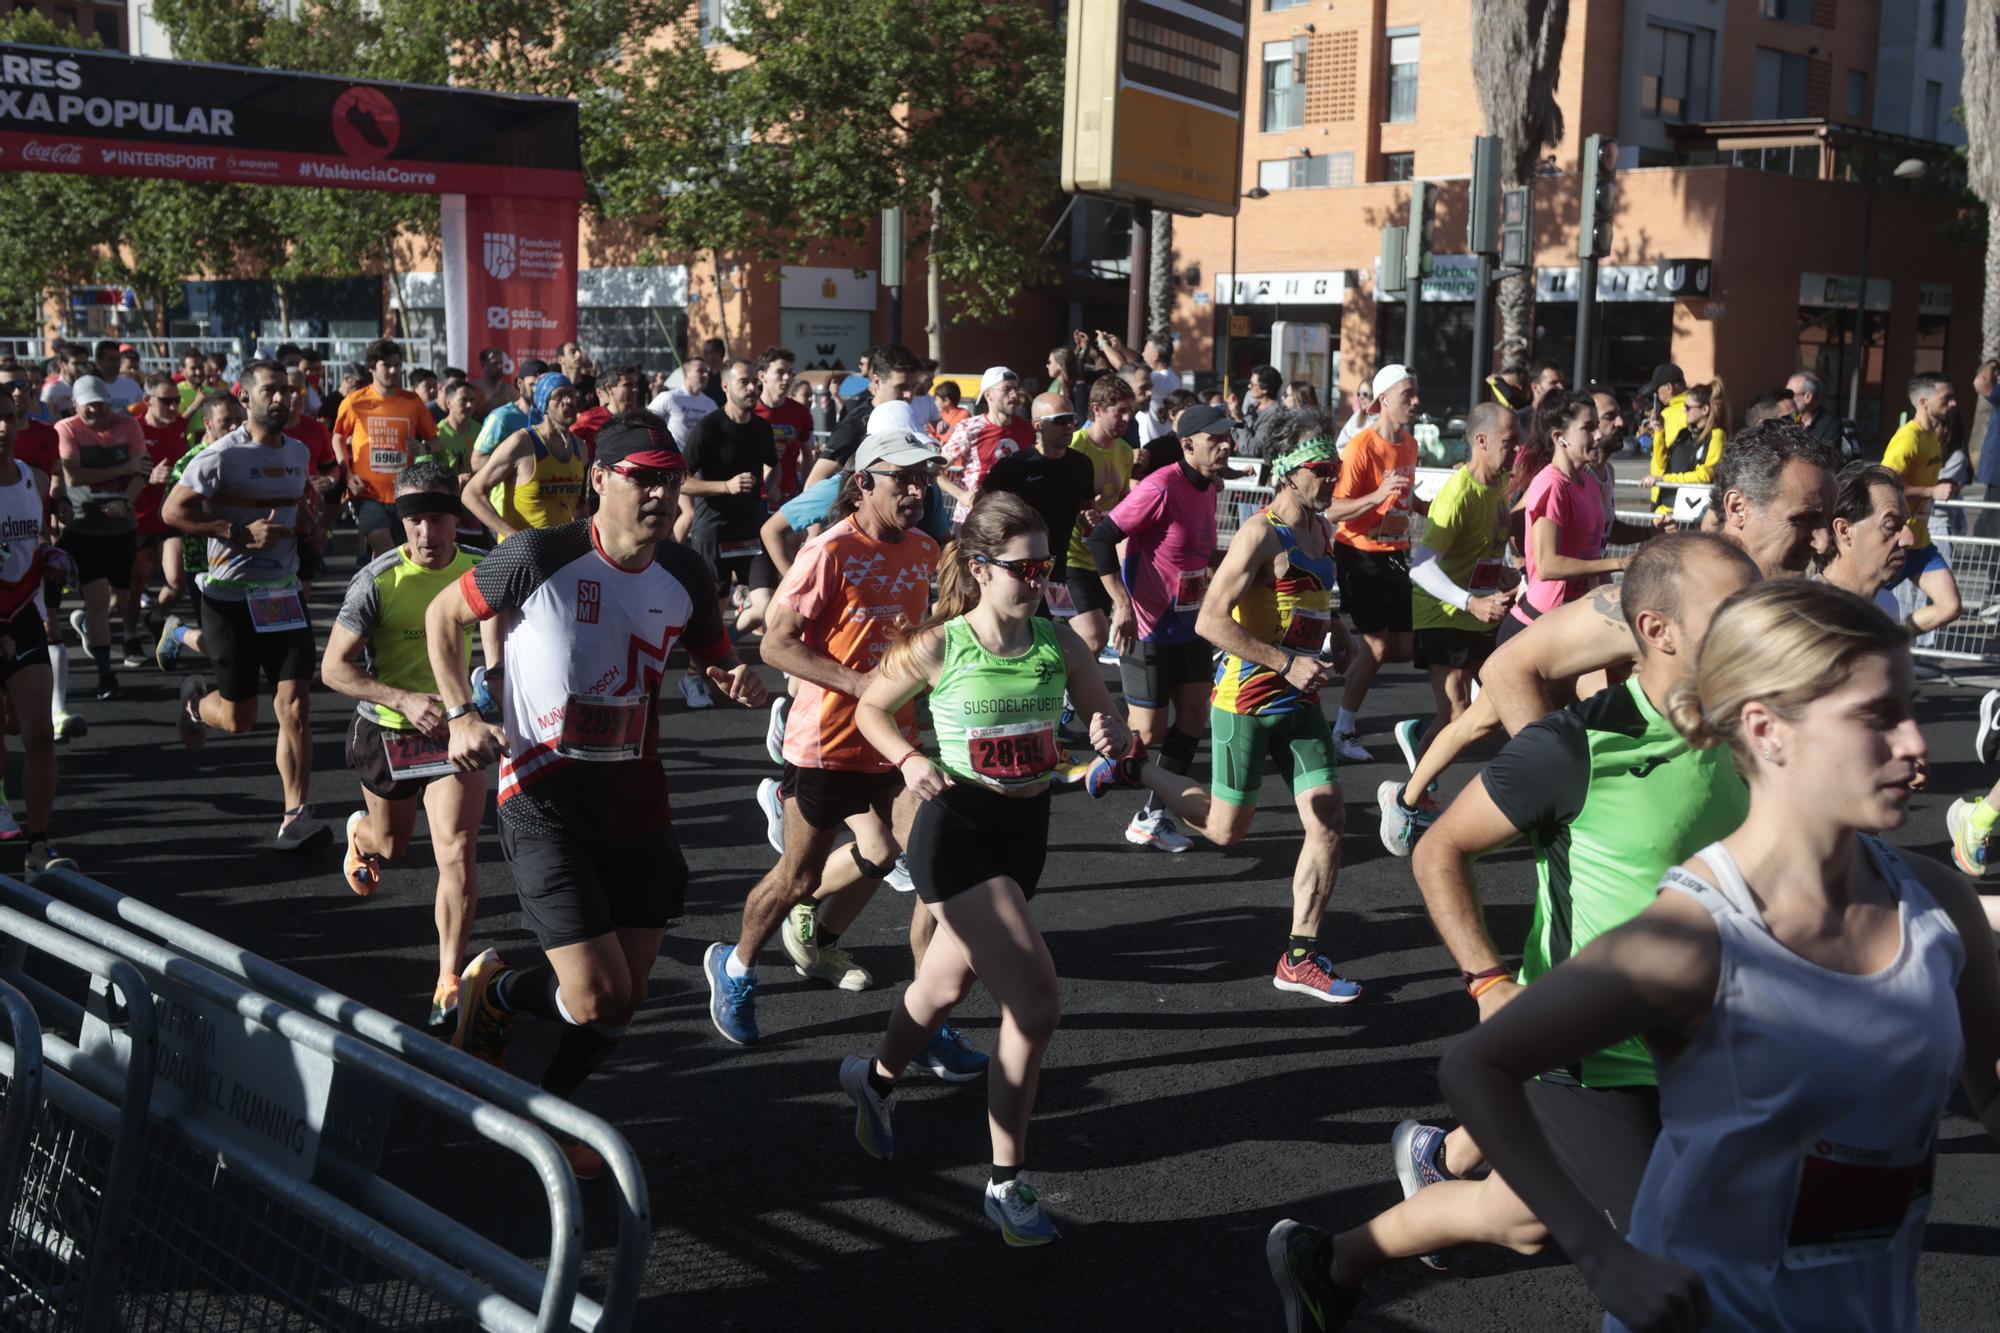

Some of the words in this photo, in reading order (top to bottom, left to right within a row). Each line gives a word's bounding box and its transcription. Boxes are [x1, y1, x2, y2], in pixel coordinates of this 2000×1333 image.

[0, 56, 81, 90] RES
[58, 95, 234, 136] POPULAR
[118, 150, 216, 170] INTERSPORT
[299, 162, 436, 185] #ValènciaCorre
[512, 319, 558, 329] popular
[228, 1082, 307, 1154] RUNNING
